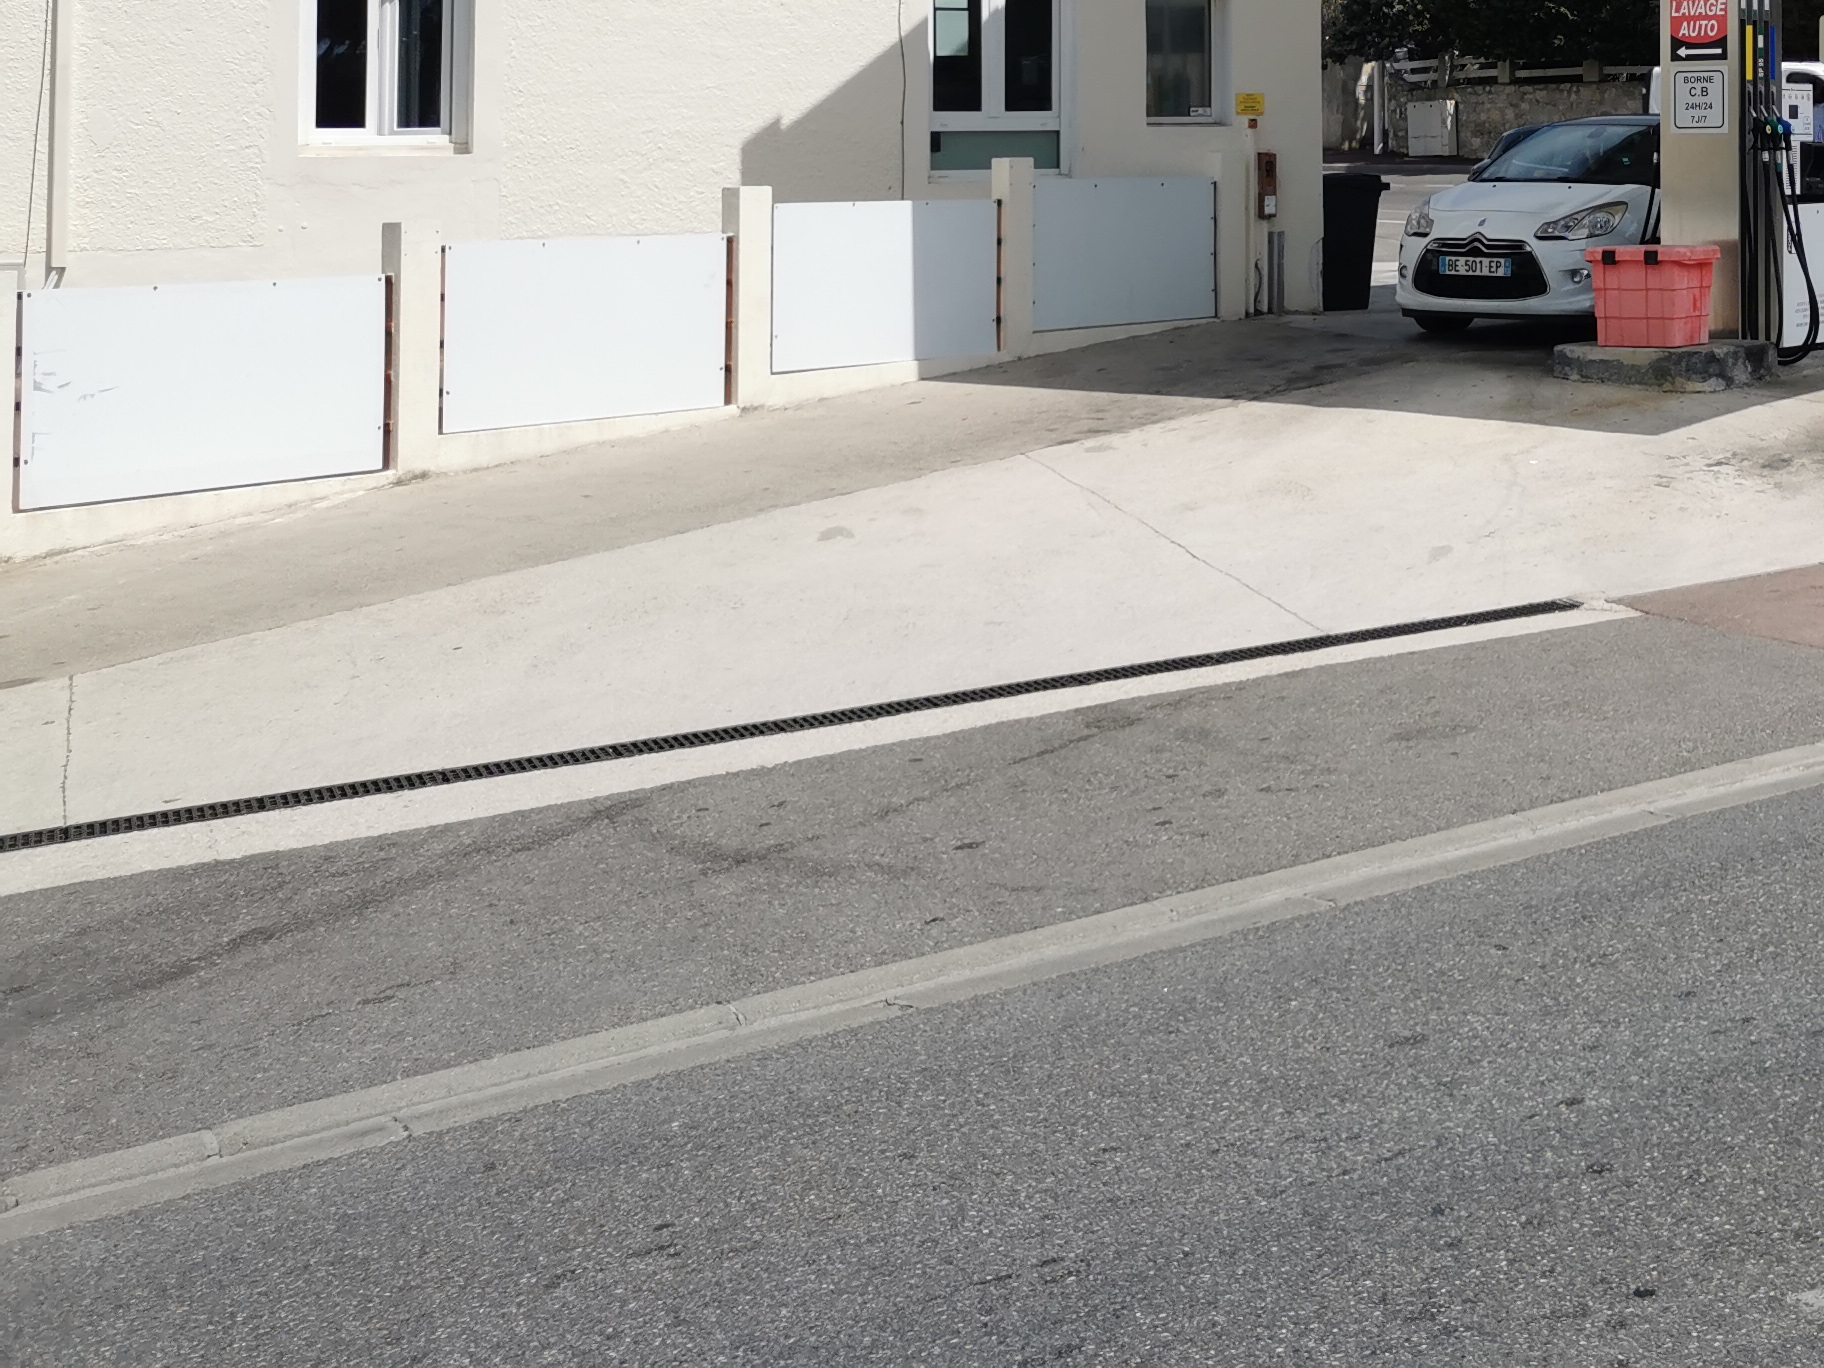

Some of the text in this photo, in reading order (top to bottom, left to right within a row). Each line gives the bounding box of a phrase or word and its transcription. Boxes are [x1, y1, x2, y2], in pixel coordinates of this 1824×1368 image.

[1671, 0, 1727, 17] LAVAGE
[1679, 20, 1718, 37] AUTO
[1683, 75, 1715, 84] BORNE
[1688, 86, 1709, 97] C.B
[1684, 101, 1713, 111] 24H/24
[1690, 115, 1708, 124] 7J/7
[1447, 258, 1502, 274] BE-501-EP
